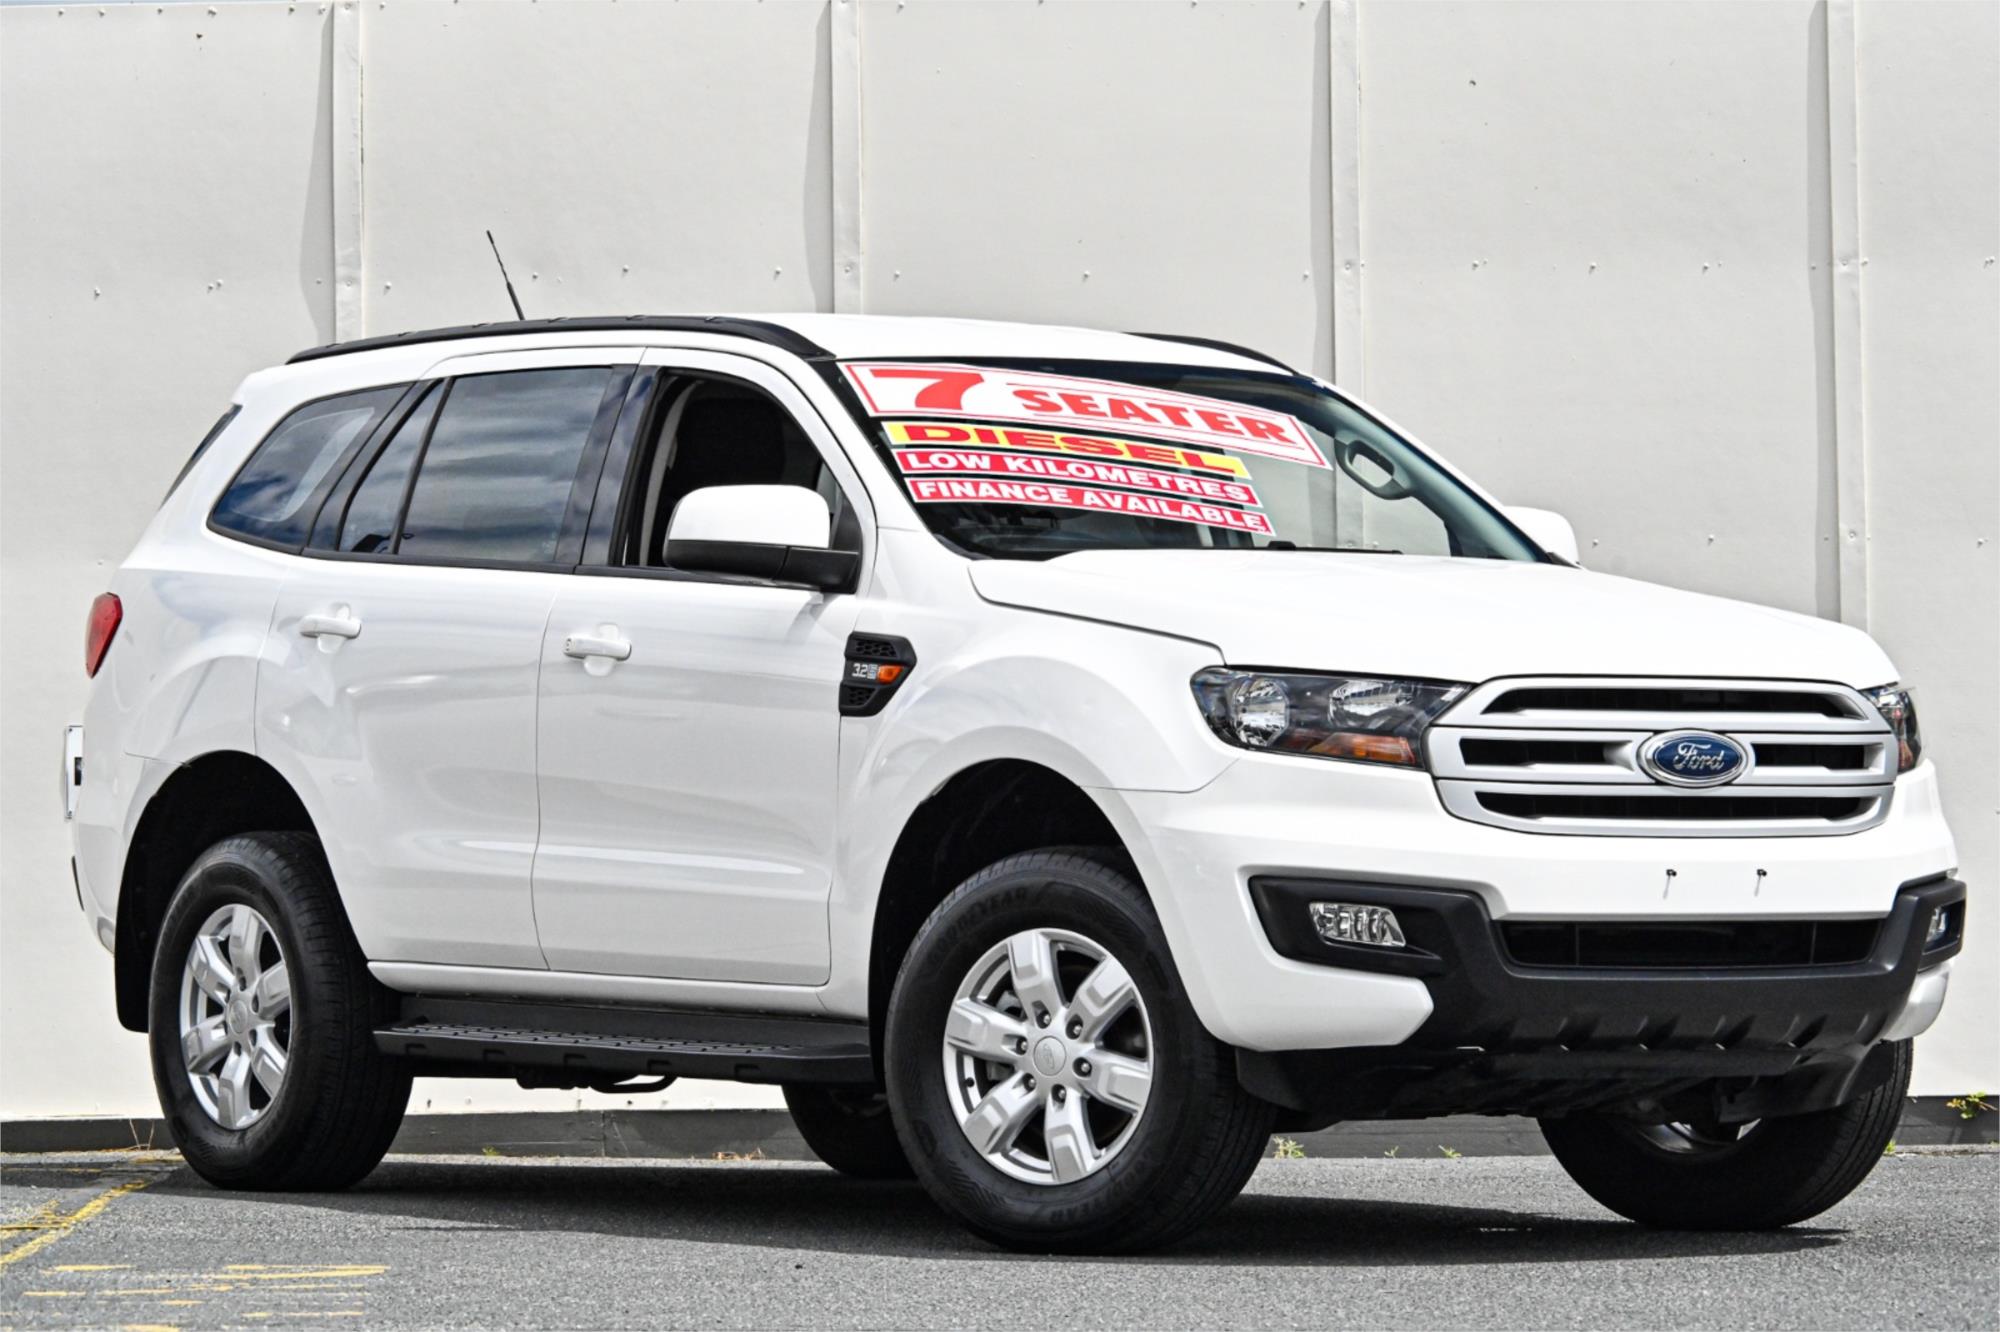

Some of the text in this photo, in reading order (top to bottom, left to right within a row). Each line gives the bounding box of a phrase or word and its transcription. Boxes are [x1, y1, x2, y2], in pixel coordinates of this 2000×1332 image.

[869, 369, 1297, 444] 7 SEATER
[903, 425, 1235, 474] DIESEL
[906, 453, 1250, 502] LOW KILOMETRES
[916, 481, 1265, 530] FINANCE AVAILABLE
[1672, 742, 1725, 770] Ford
